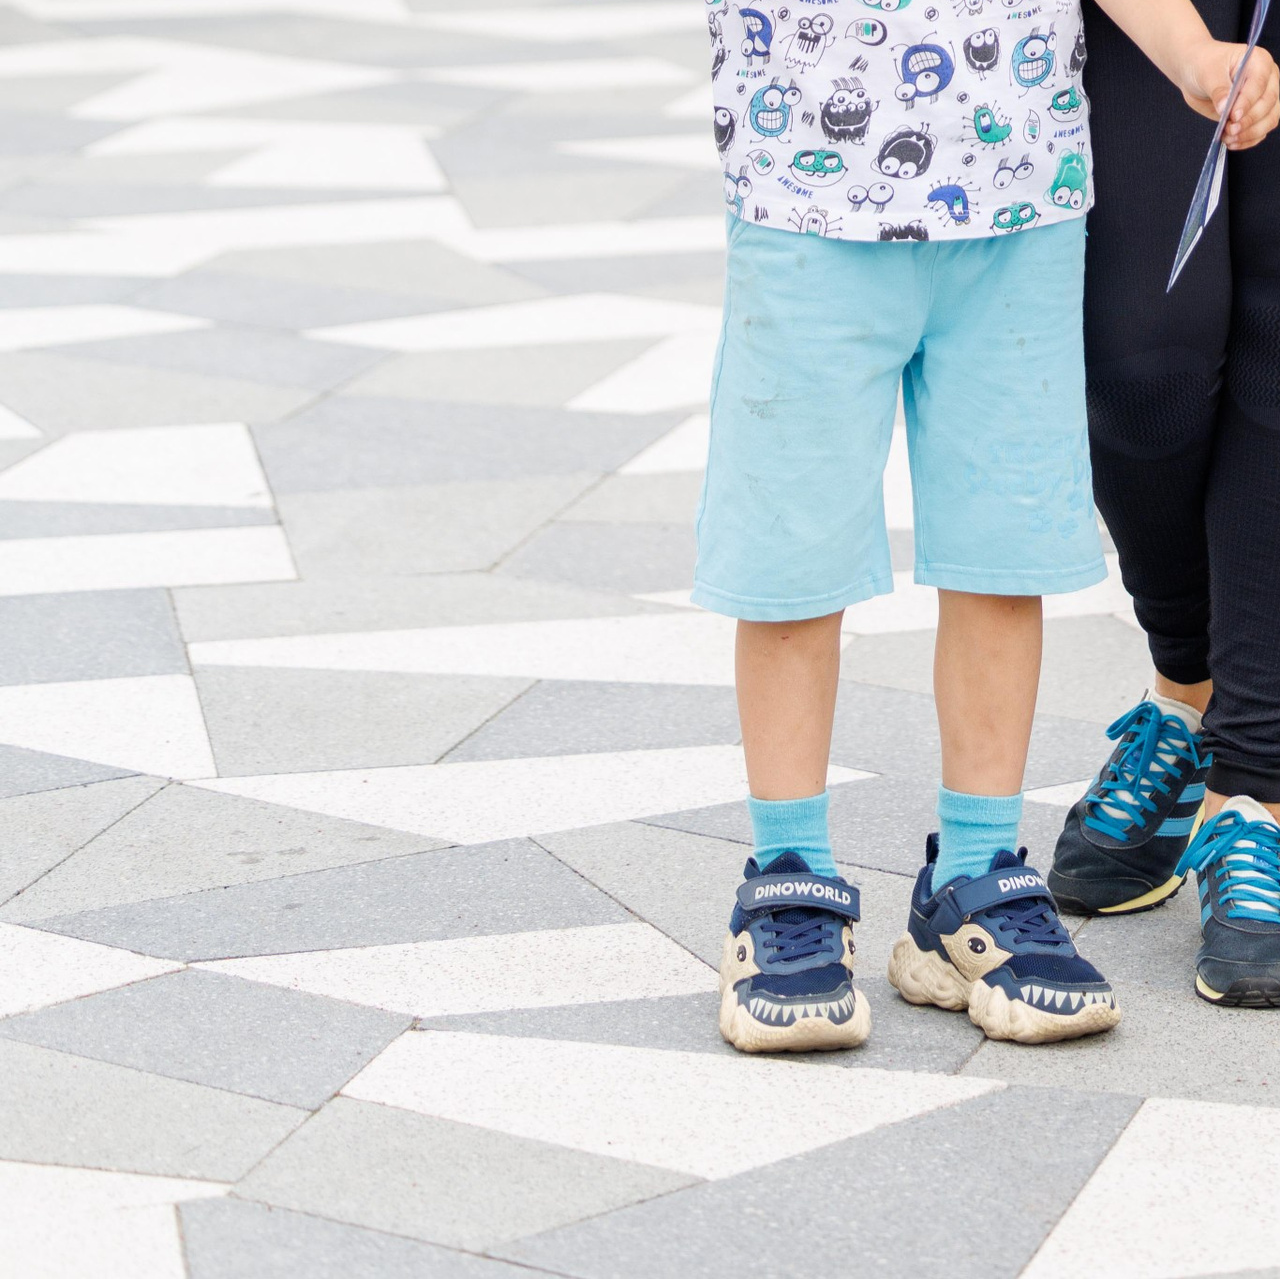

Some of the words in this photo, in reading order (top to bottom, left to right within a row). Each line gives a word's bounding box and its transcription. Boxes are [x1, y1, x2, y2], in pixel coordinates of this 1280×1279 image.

[1006, 5, 1043, 20] AWESOME
[855, 22, 877, 37] HOP
[736, 68, 767, 79] AWESOME
[1053, 123, 1085, 139] AWESOME
[777, 175, 814, 199] AWESOME
[754, 882, 851, 905] DINOWORLD
